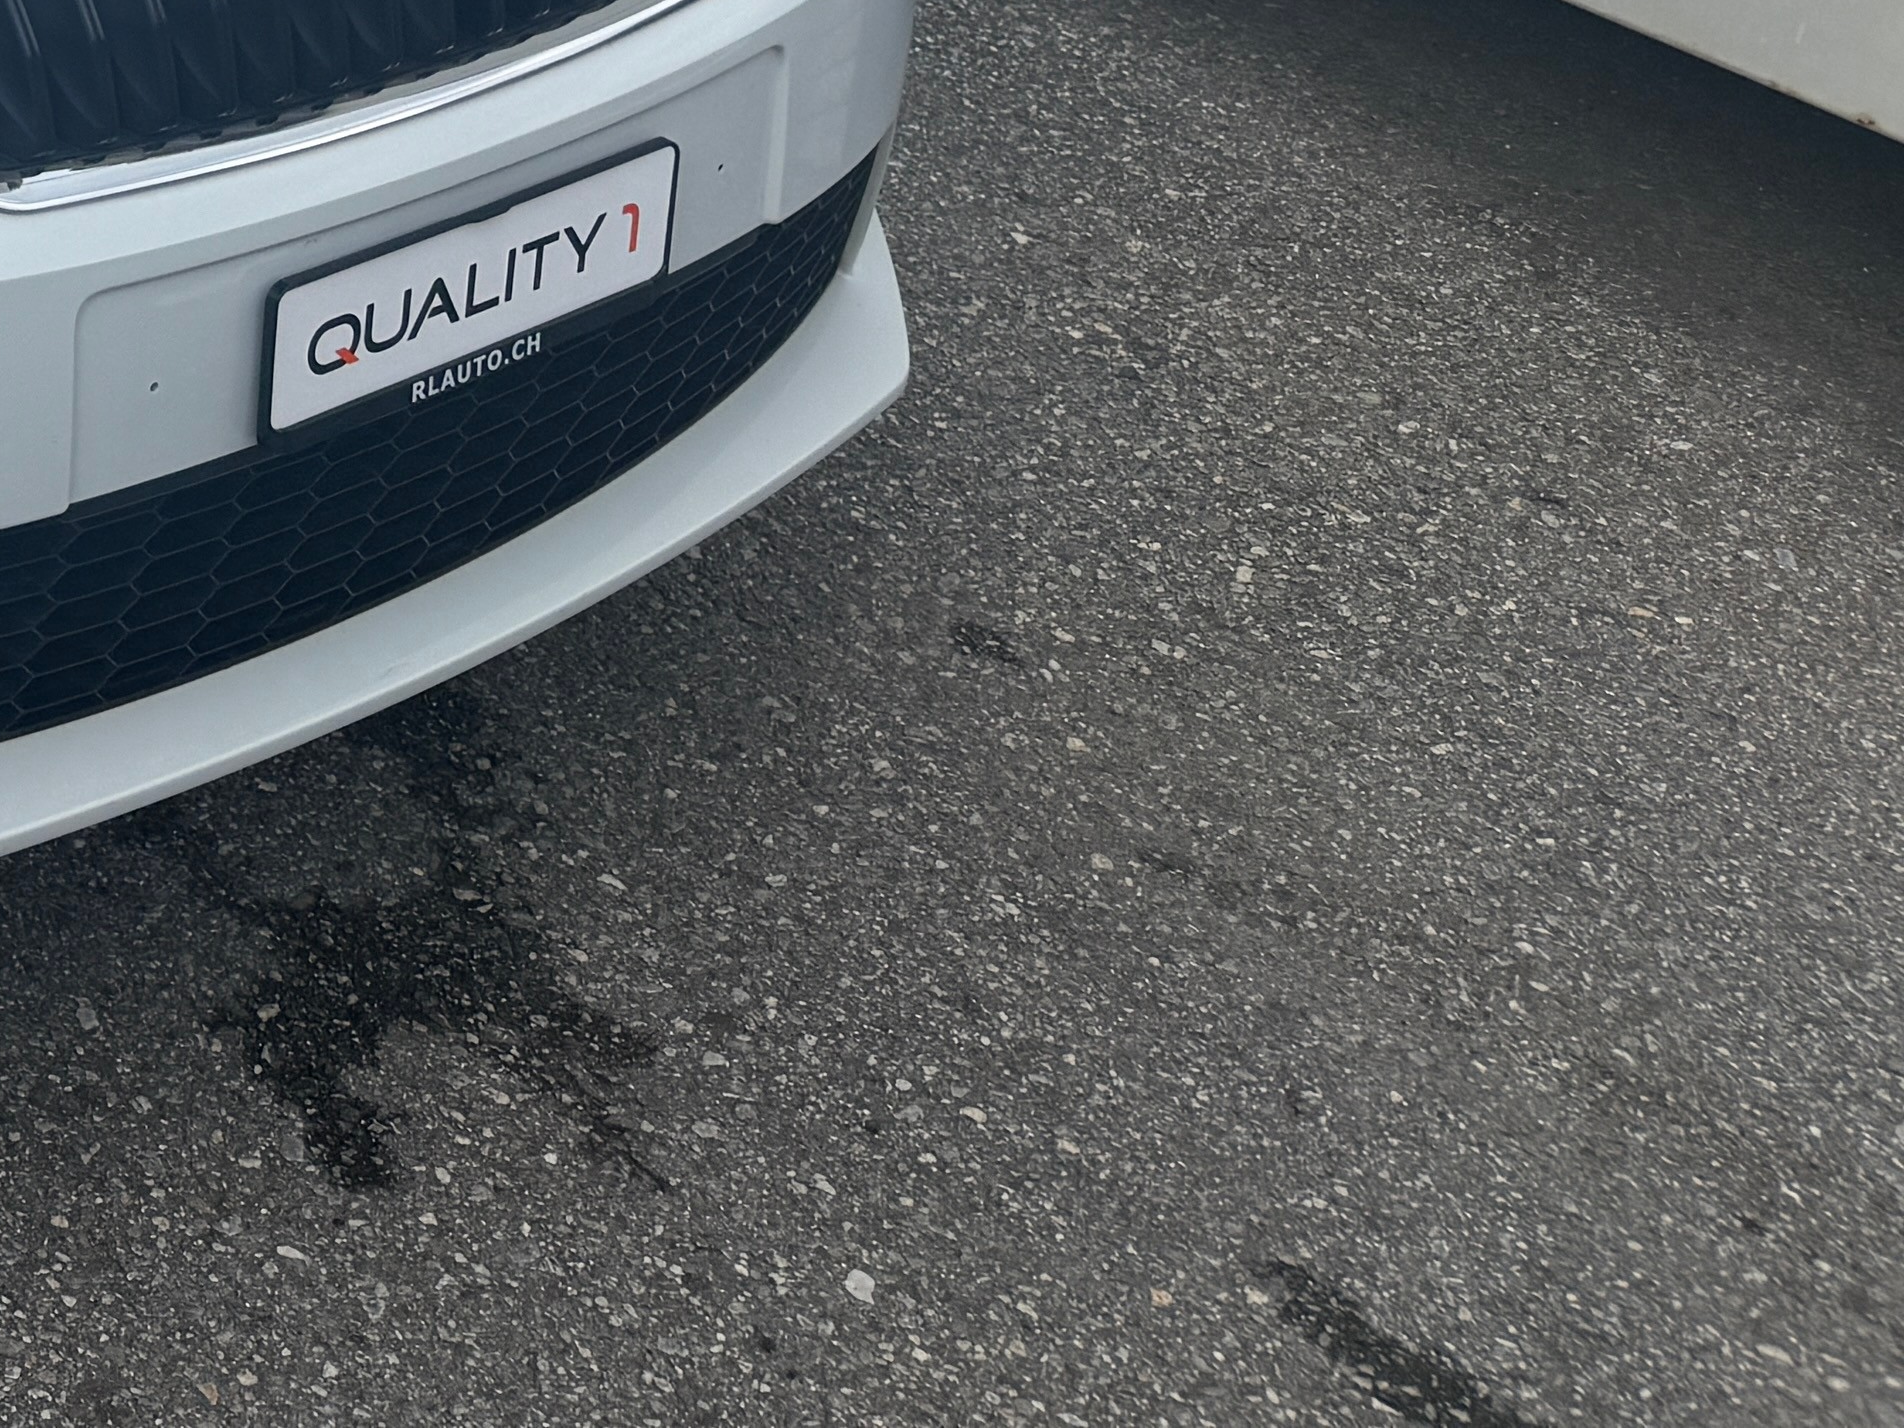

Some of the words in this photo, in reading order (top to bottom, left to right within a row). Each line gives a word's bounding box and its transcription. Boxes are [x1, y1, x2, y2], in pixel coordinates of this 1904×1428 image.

[307, 212, 607, 376] QUALITY
[622, 202, 640, 253] 1
[411, 332, 542, 404] RLAUTO.CH
